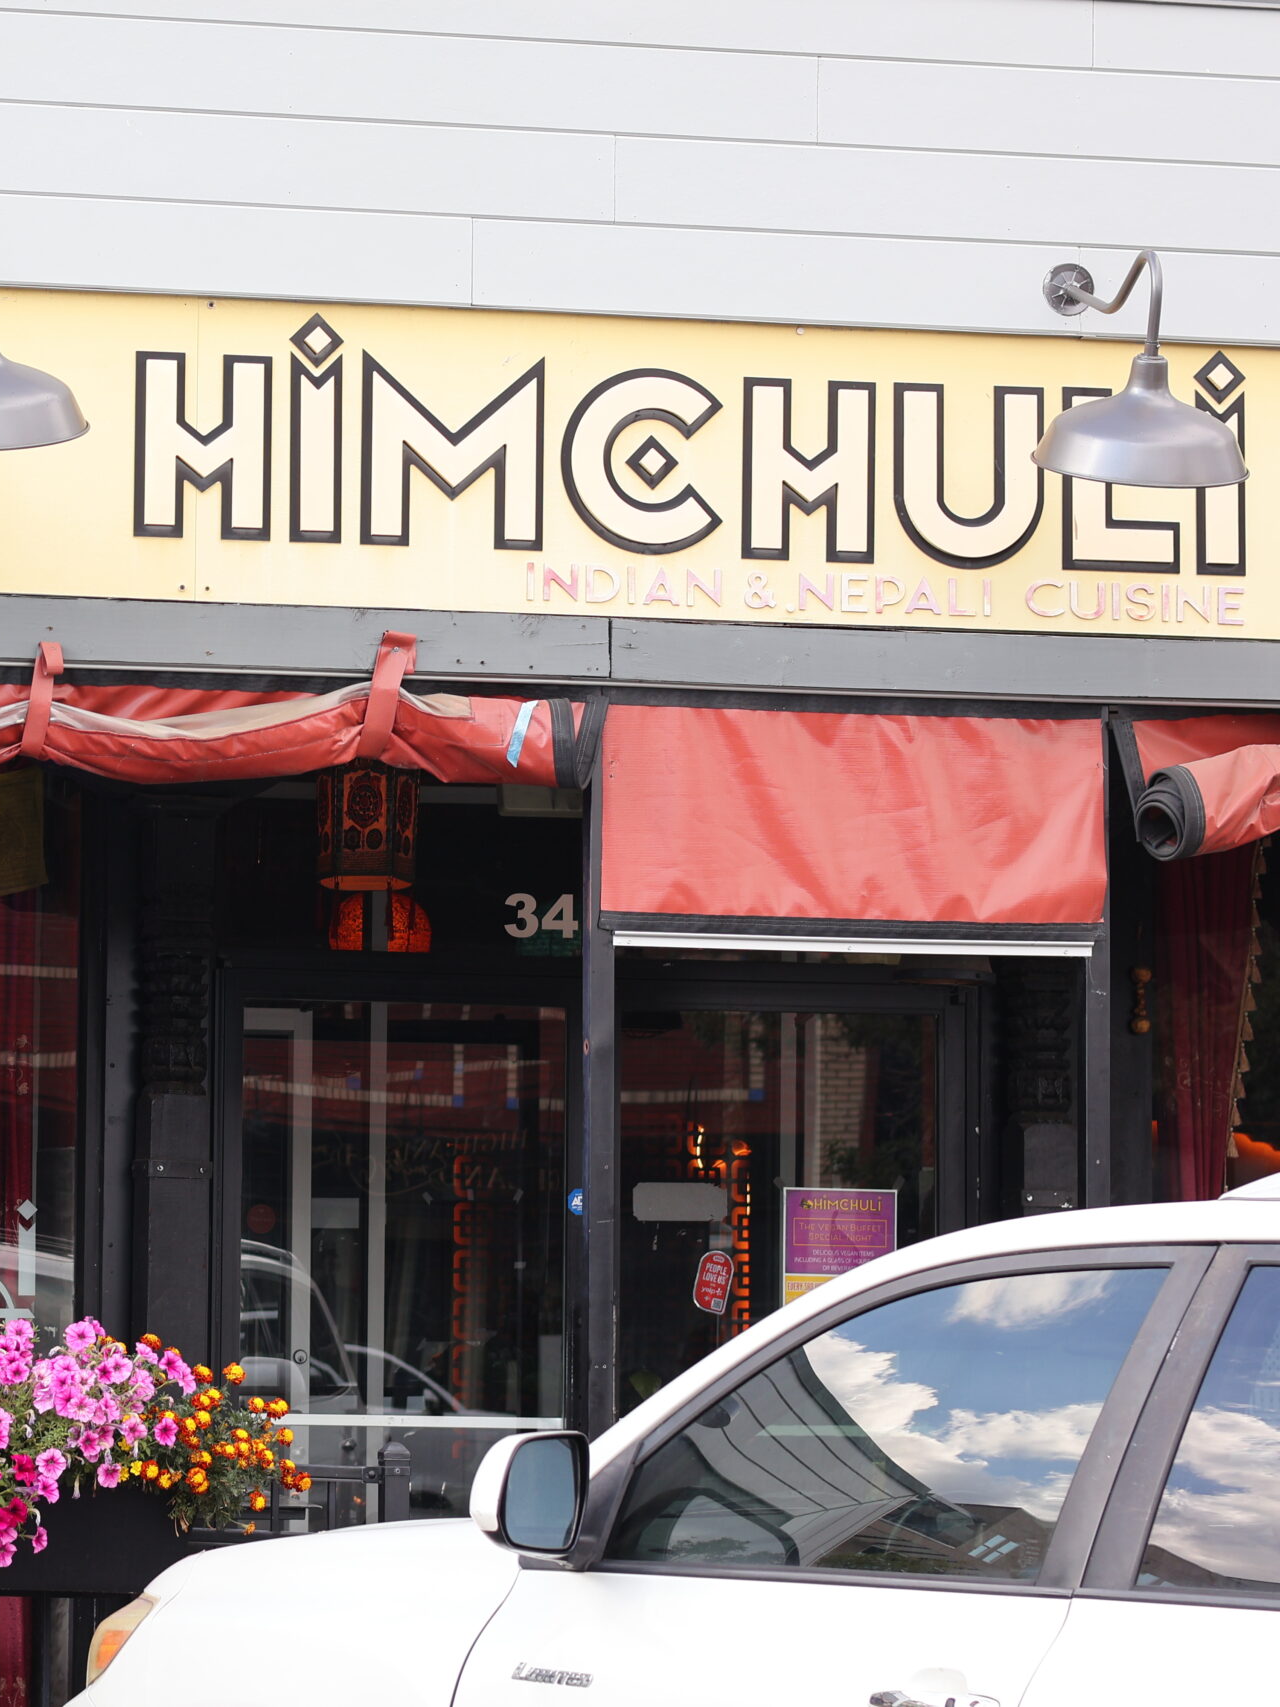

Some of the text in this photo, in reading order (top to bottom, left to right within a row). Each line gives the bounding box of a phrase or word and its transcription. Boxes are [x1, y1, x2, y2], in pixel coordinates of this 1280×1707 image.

[526, 562, 1246, 626] INDIAN & NEPALI CUISINE
